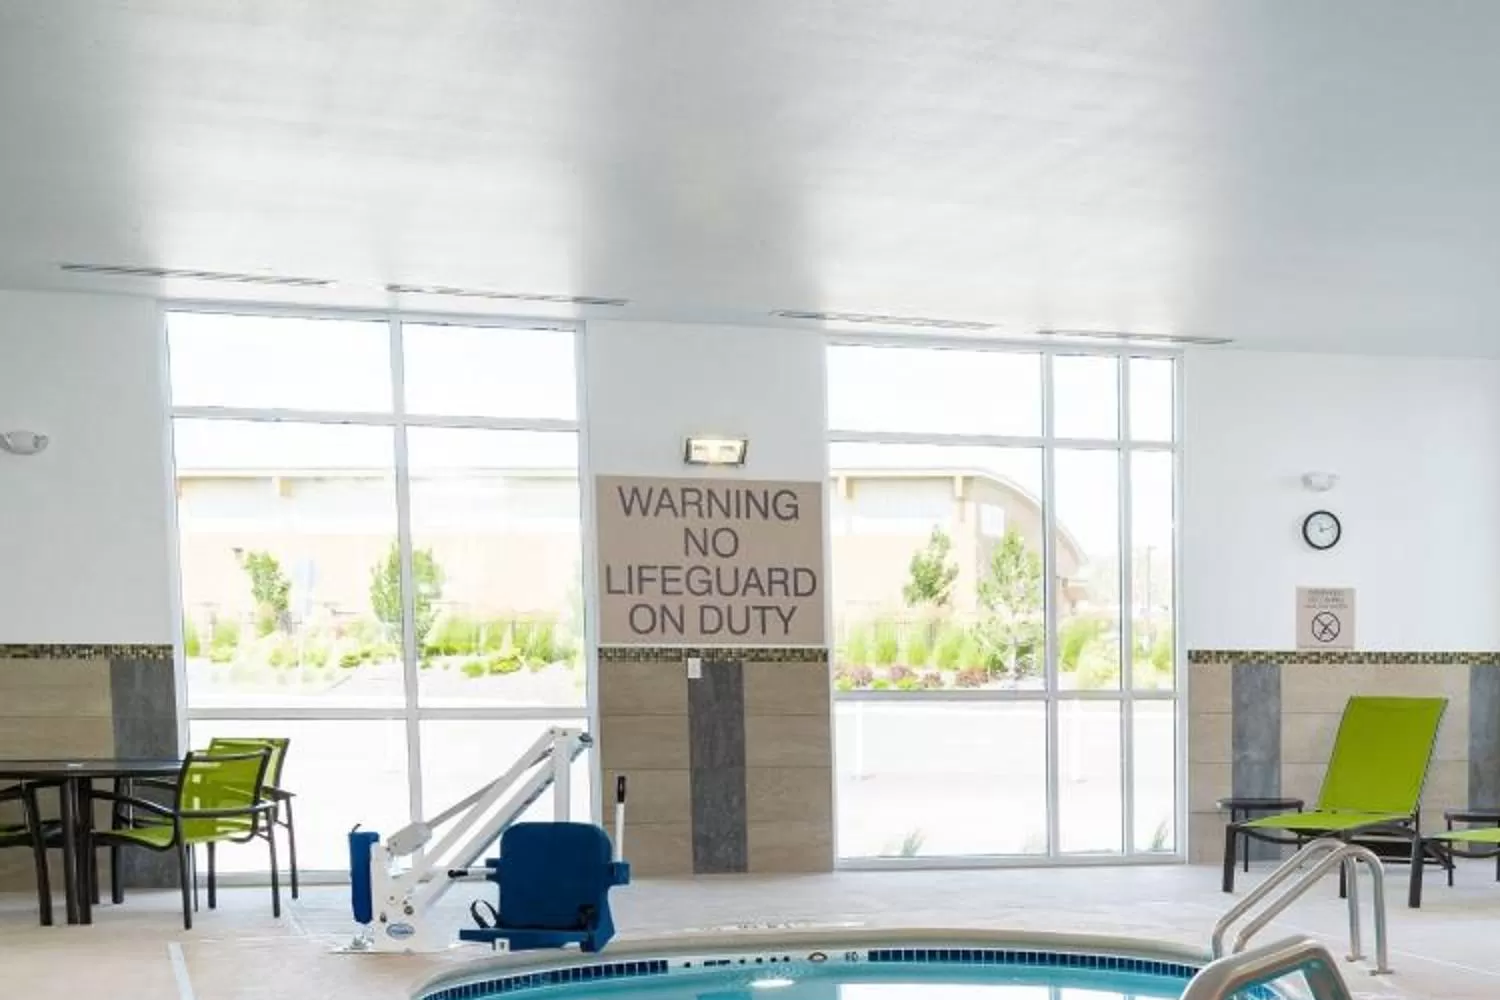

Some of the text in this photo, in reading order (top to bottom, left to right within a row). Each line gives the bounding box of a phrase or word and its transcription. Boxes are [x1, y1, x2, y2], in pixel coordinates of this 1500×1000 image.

[617, 485, 799, 521] WARNING
[684, 526, 739, 558] NO
[605, 563, 817, 597] LIFEGUARD
[628, 603, 797, 636] ON DUTY
